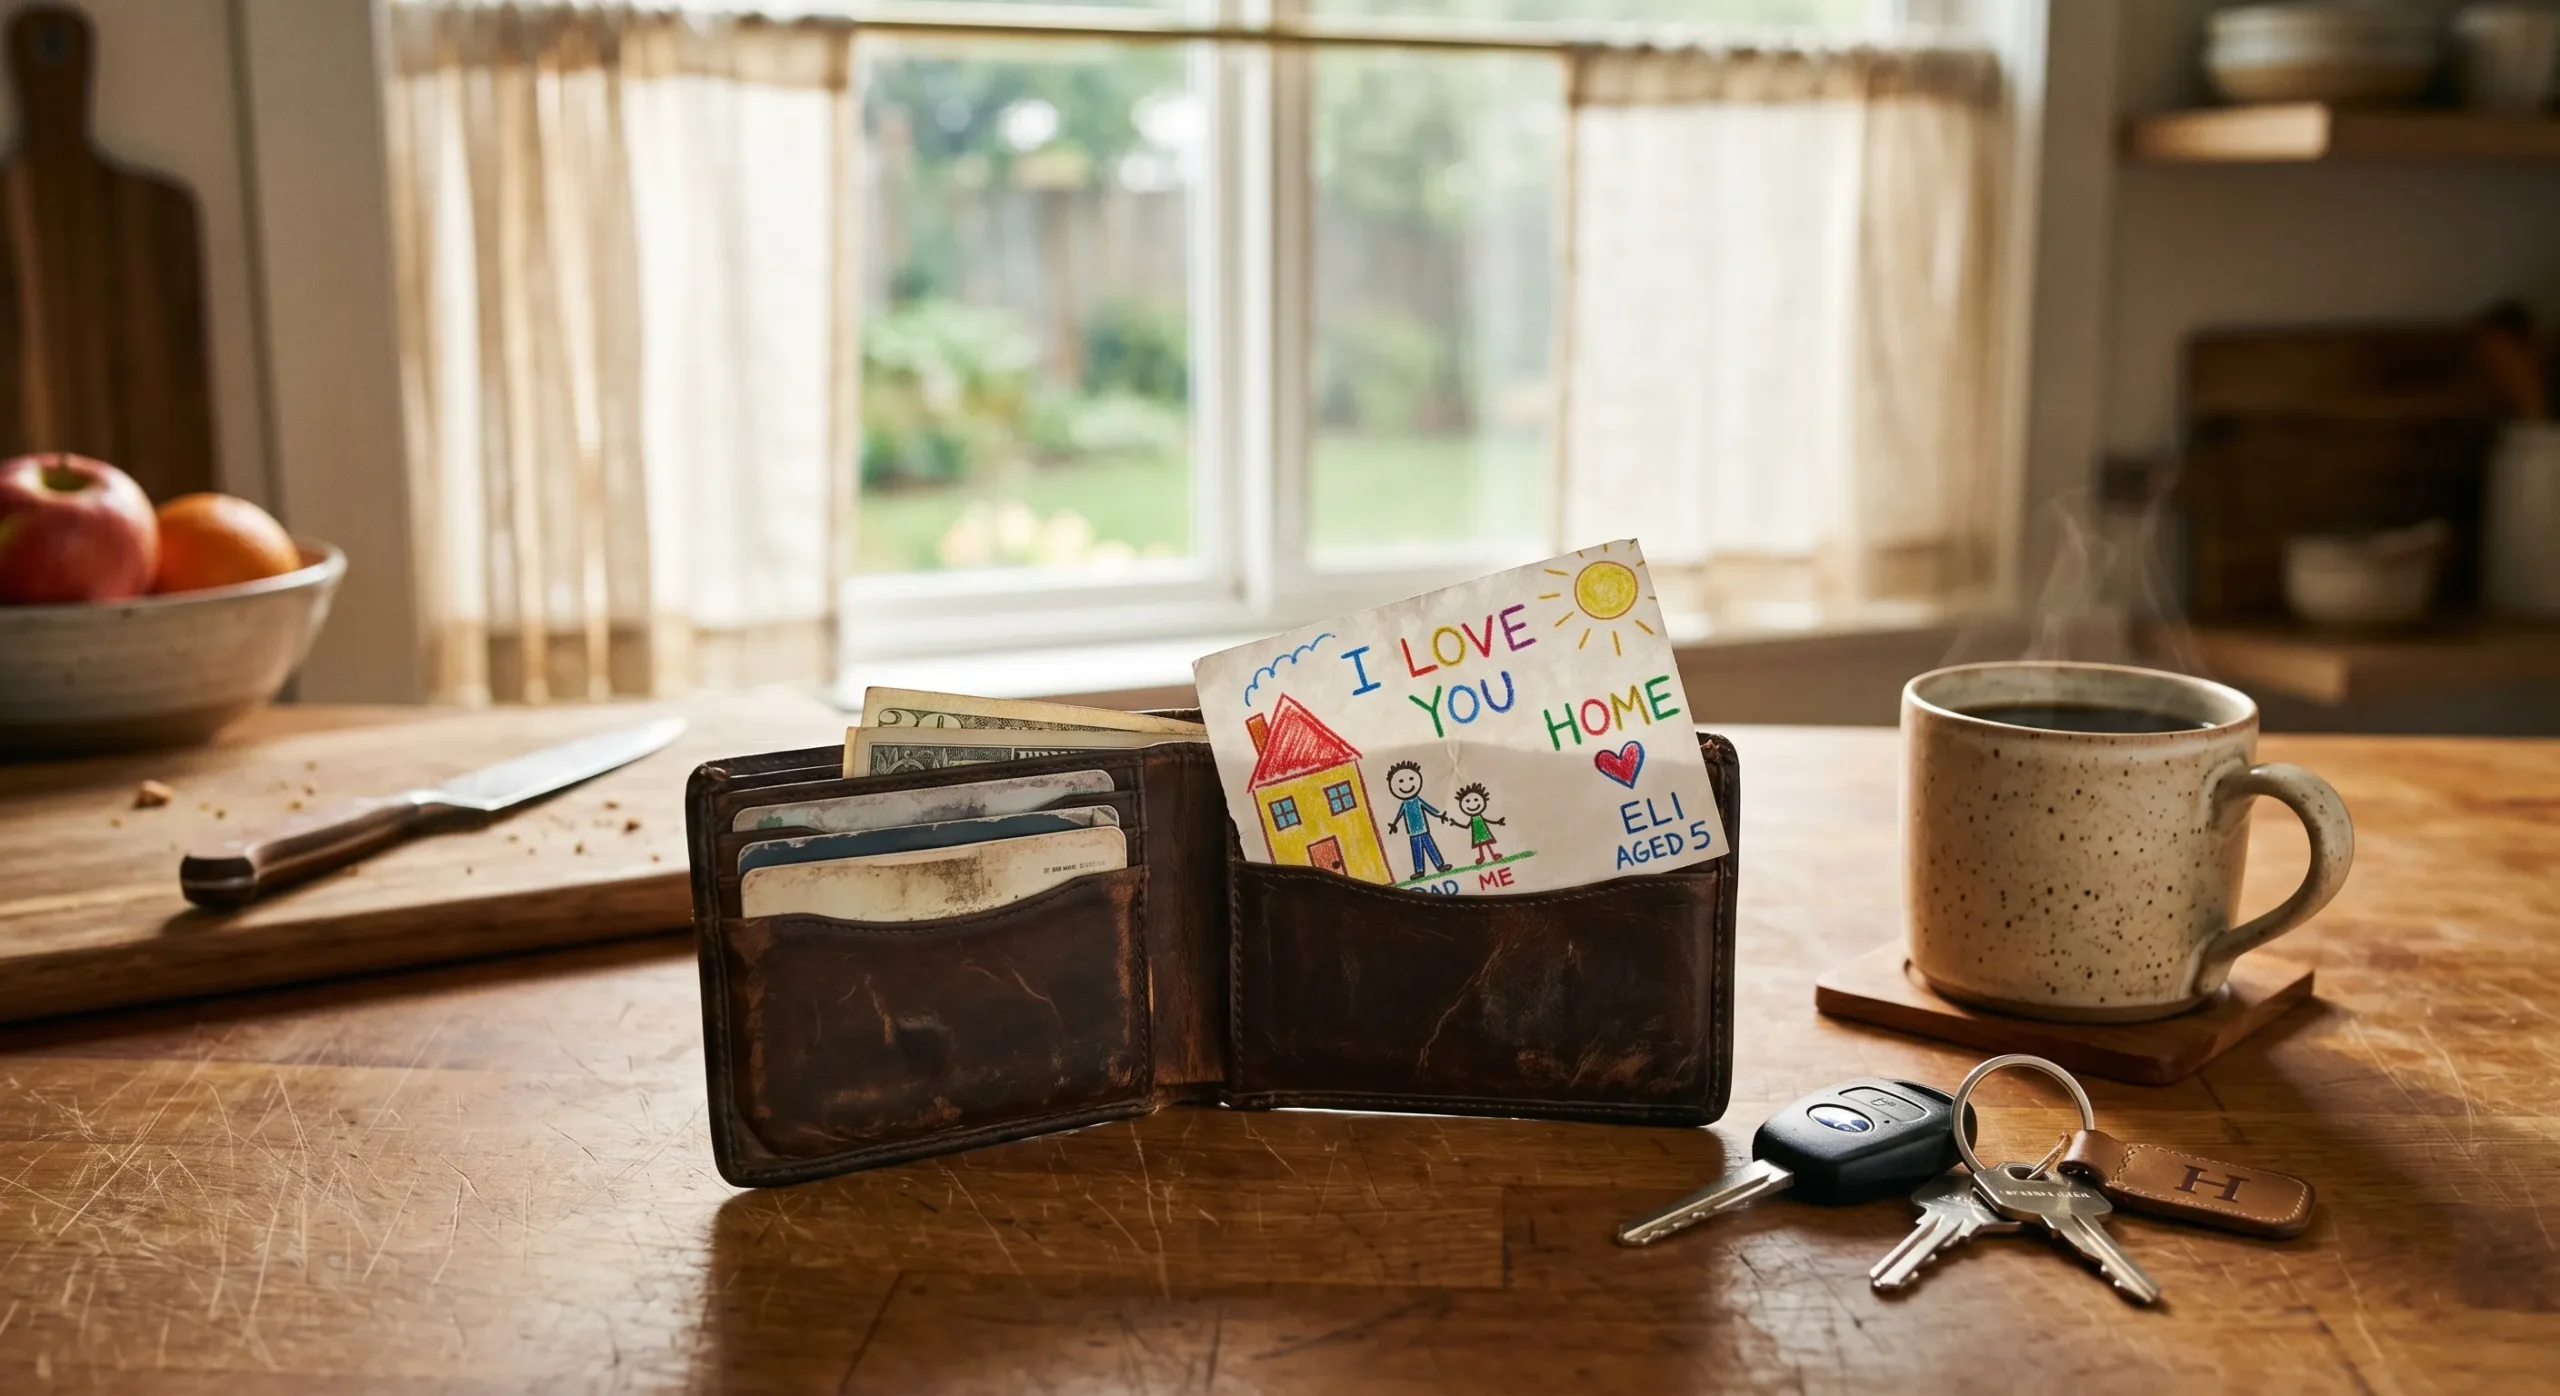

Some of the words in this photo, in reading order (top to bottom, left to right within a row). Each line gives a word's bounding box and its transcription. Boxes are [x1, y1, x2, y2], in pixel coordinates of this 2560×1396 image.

[1340, 645, 1381, 696] I
[1400, 603, 1537, 678] LOVE
[1408, 670, 1515, 738] YOU
[1543, 674, 1681, 751] HOME
[1620, 791, 1684, 835] ELI
[1617, 832, 1684, 871] AGED
[1690, 820, 1711, 851] 5
[1478, 866, 1515, 892] ME
[2173, 1164, 2250, 1203] H
